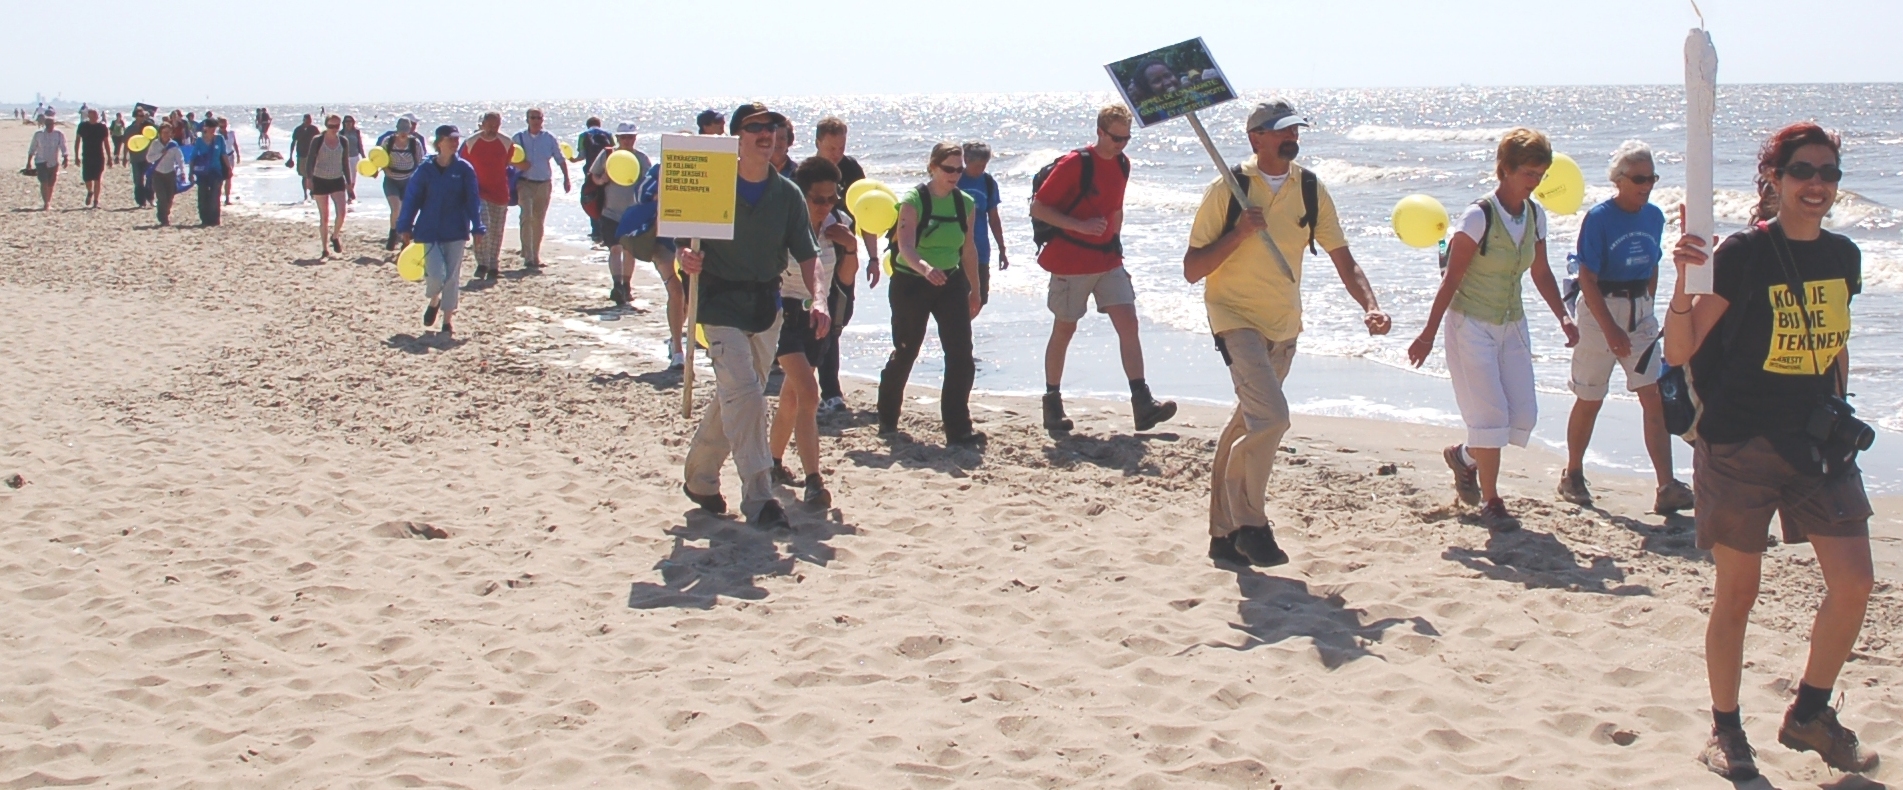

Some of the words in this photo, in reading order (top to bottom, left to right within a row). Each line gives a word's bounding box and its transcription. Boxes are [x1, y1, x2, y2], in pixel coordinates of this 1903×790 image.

[666, 154, 708, 163] VERKRACHTING
[665, 185, 710, 193] OORLOGSWAPEN
[1811, 286, 1827, 305] JE
[1778, 311, 1800, 329] BIJ
